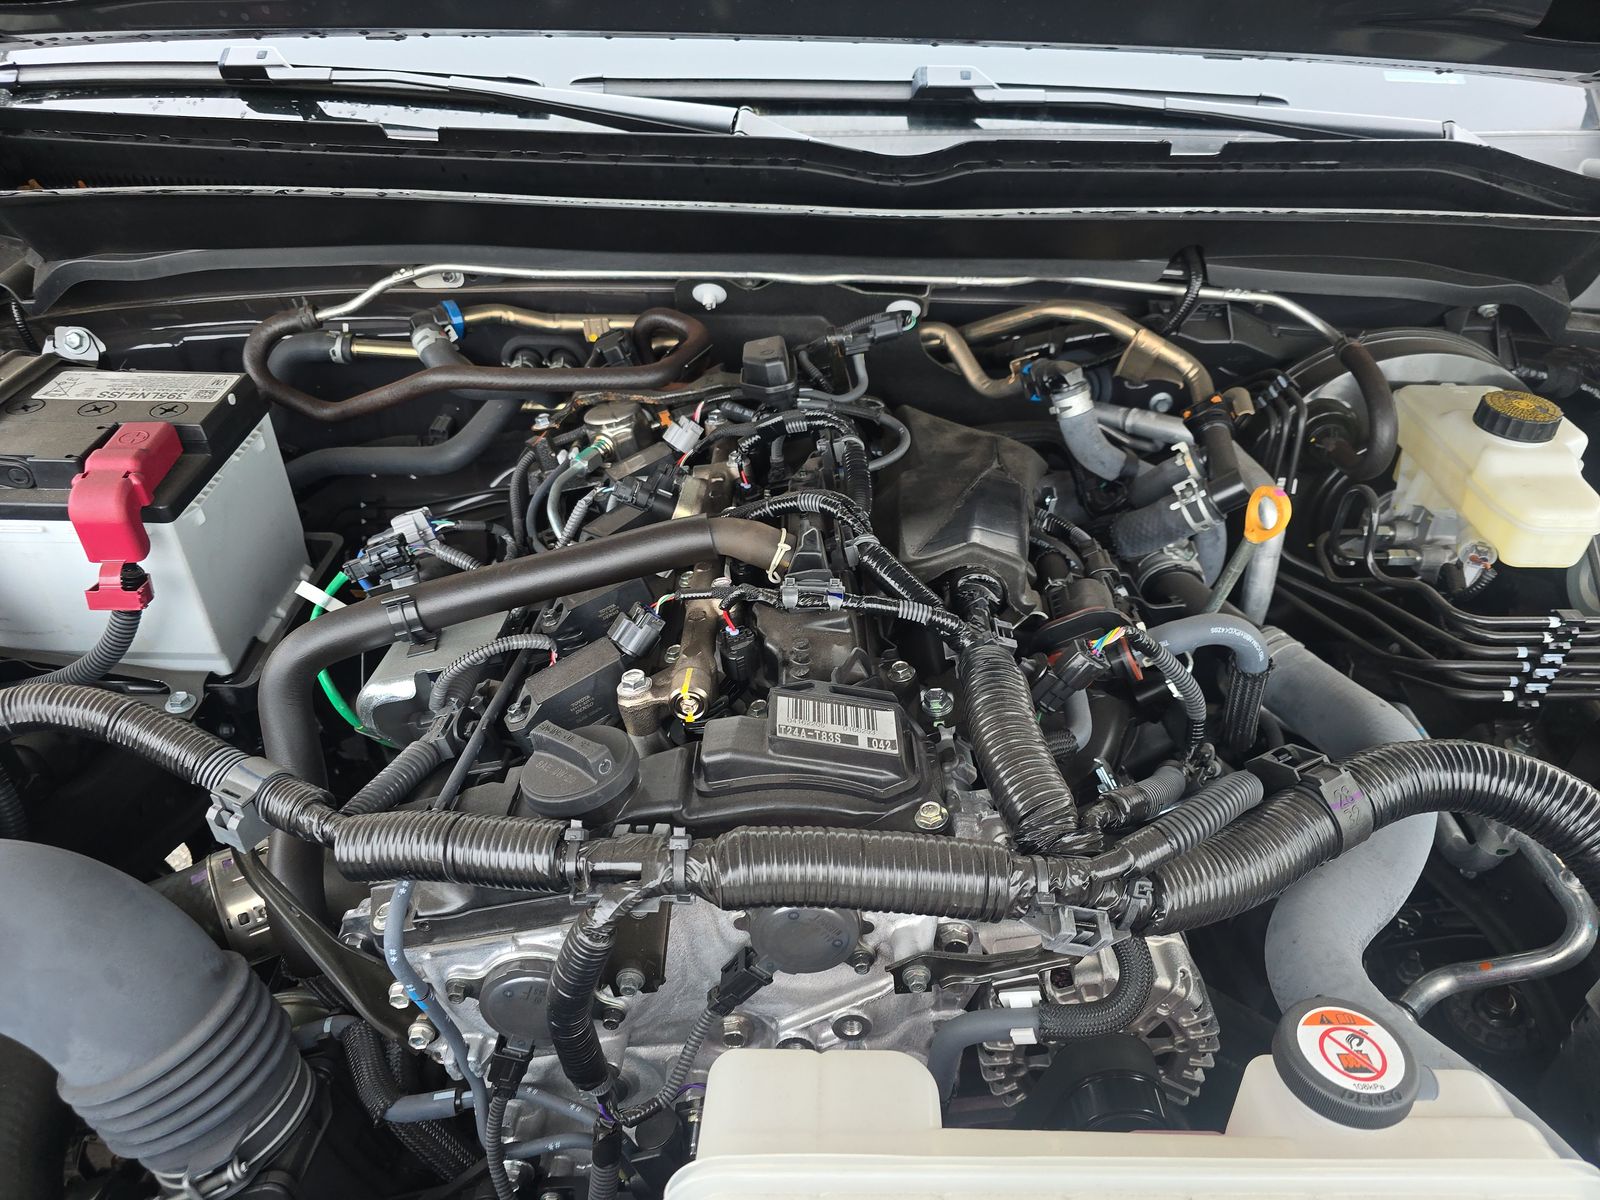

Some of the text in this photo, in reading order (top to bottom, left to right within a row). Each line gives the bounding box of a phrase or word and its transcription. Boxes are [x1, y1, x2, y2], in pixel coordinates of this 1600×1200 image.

[97, 390, 187, 400] 395LN4-ISS
[779, 725, 892, 751] T24A-T83S 042
[1341, 1089, 1403, 1107] DENSO
